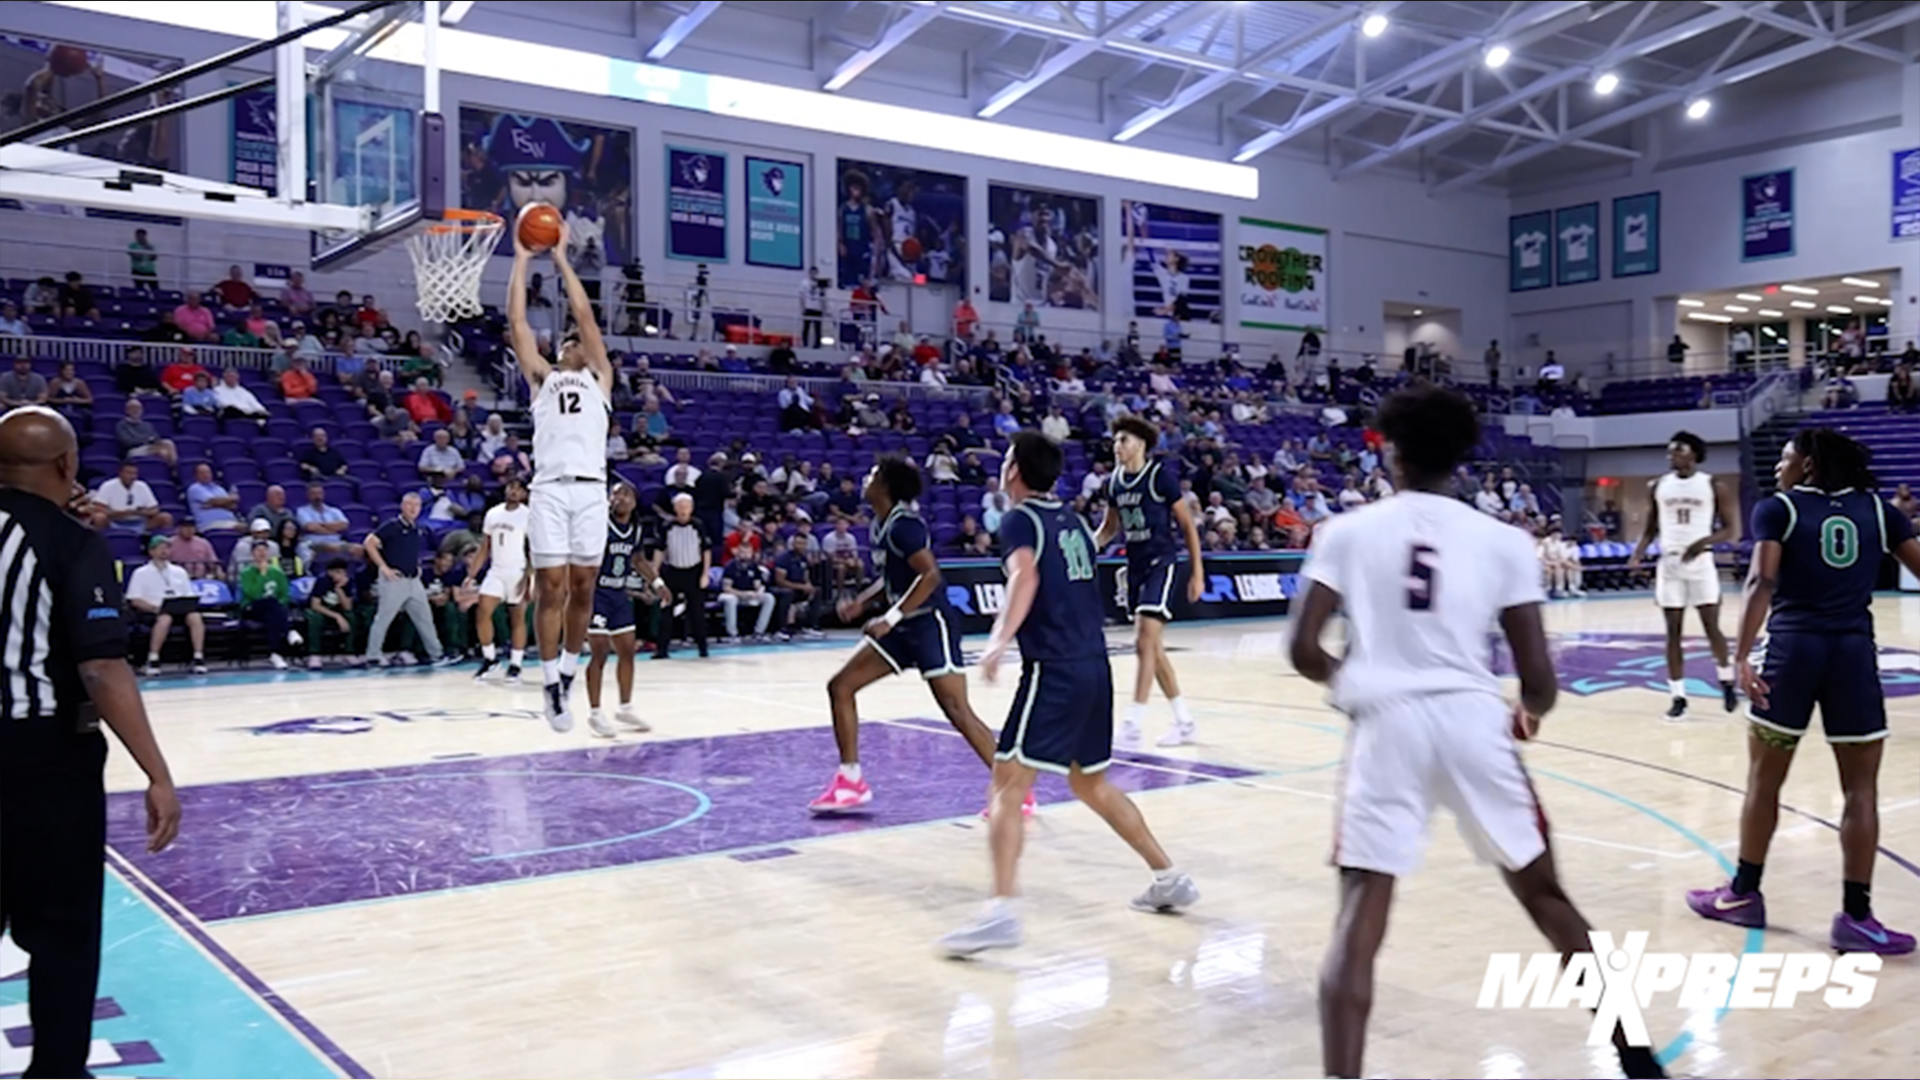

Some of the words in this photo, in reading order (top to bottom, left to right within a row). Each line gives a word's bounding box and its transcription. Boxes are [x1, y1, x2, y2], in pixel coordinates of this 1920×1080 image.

[510, 128, 547, 158] FSW
[1238, 244, 1323, 274] CROWTHER
[1244, 266, 1314, 292] ROOFING
[559, 391, 582, 415] 12
[1058, 528, 1094, 581] 11
[1820, 515, 1859, 569] 0
[1407, 543, 1439, 612] 5
[945, 585, 976, 615] R
